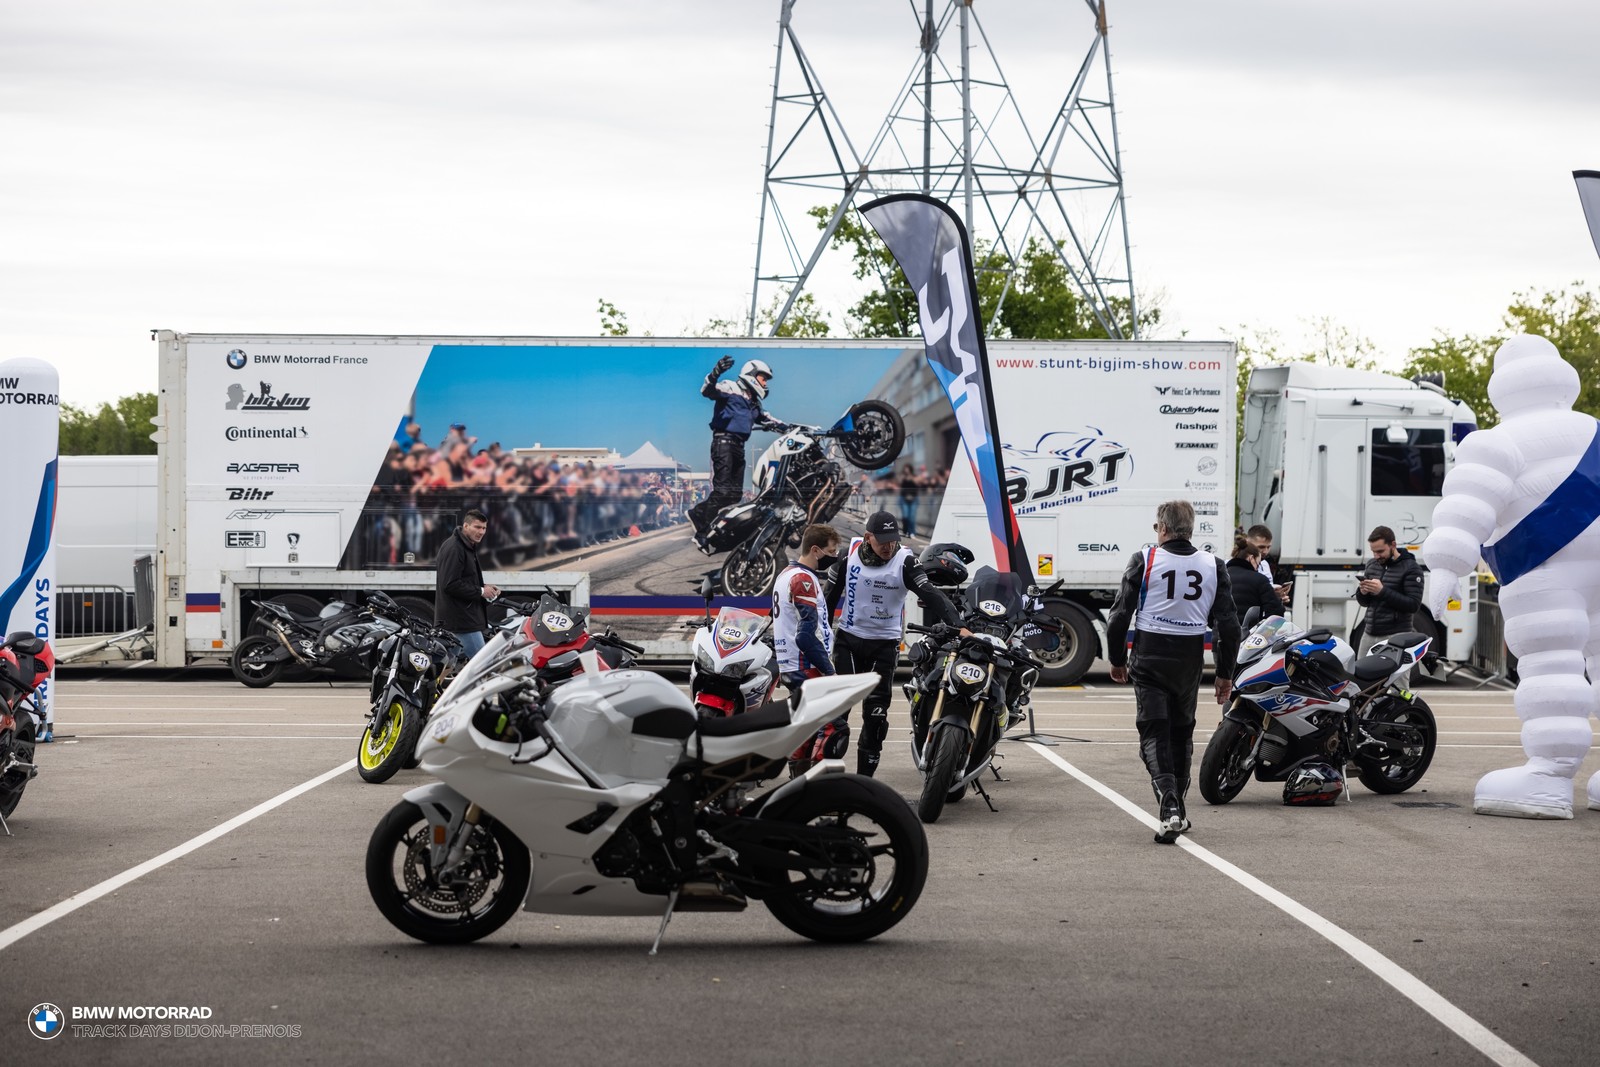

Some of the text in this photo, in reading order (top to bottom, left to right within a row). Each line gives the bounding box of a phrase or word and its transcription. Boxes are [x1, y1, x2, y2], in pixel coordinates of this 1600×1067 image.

[254, 355, 368, 365] BMW Motorrad France
[996, 357, 1221, 372] www.stunt-bigjim-show.com
[1193, 387, 1221, 396] Performance
[0, 393, 59, 406] TORRAD
[225, 426, 297, 441] Continental
[227, 463, 300, 474] BAGSTER
[1006, 450, 1129, 505] BJRT
[225, 488, 274, 500] Bihr
[1041, 494, 1083, 510] Racing
[1088, 486, 1119, 498] Team
[1078, 543, 1120, 552] SENA
[1161, 569, 1203, 601] 13
[984, 602, 1001, 612] 216
[548, 614, 567, 628] 212
[724, 628, 741, 638] 220
[413, 654, 429, 667] 211
[961, 666, 981, 679] 210
